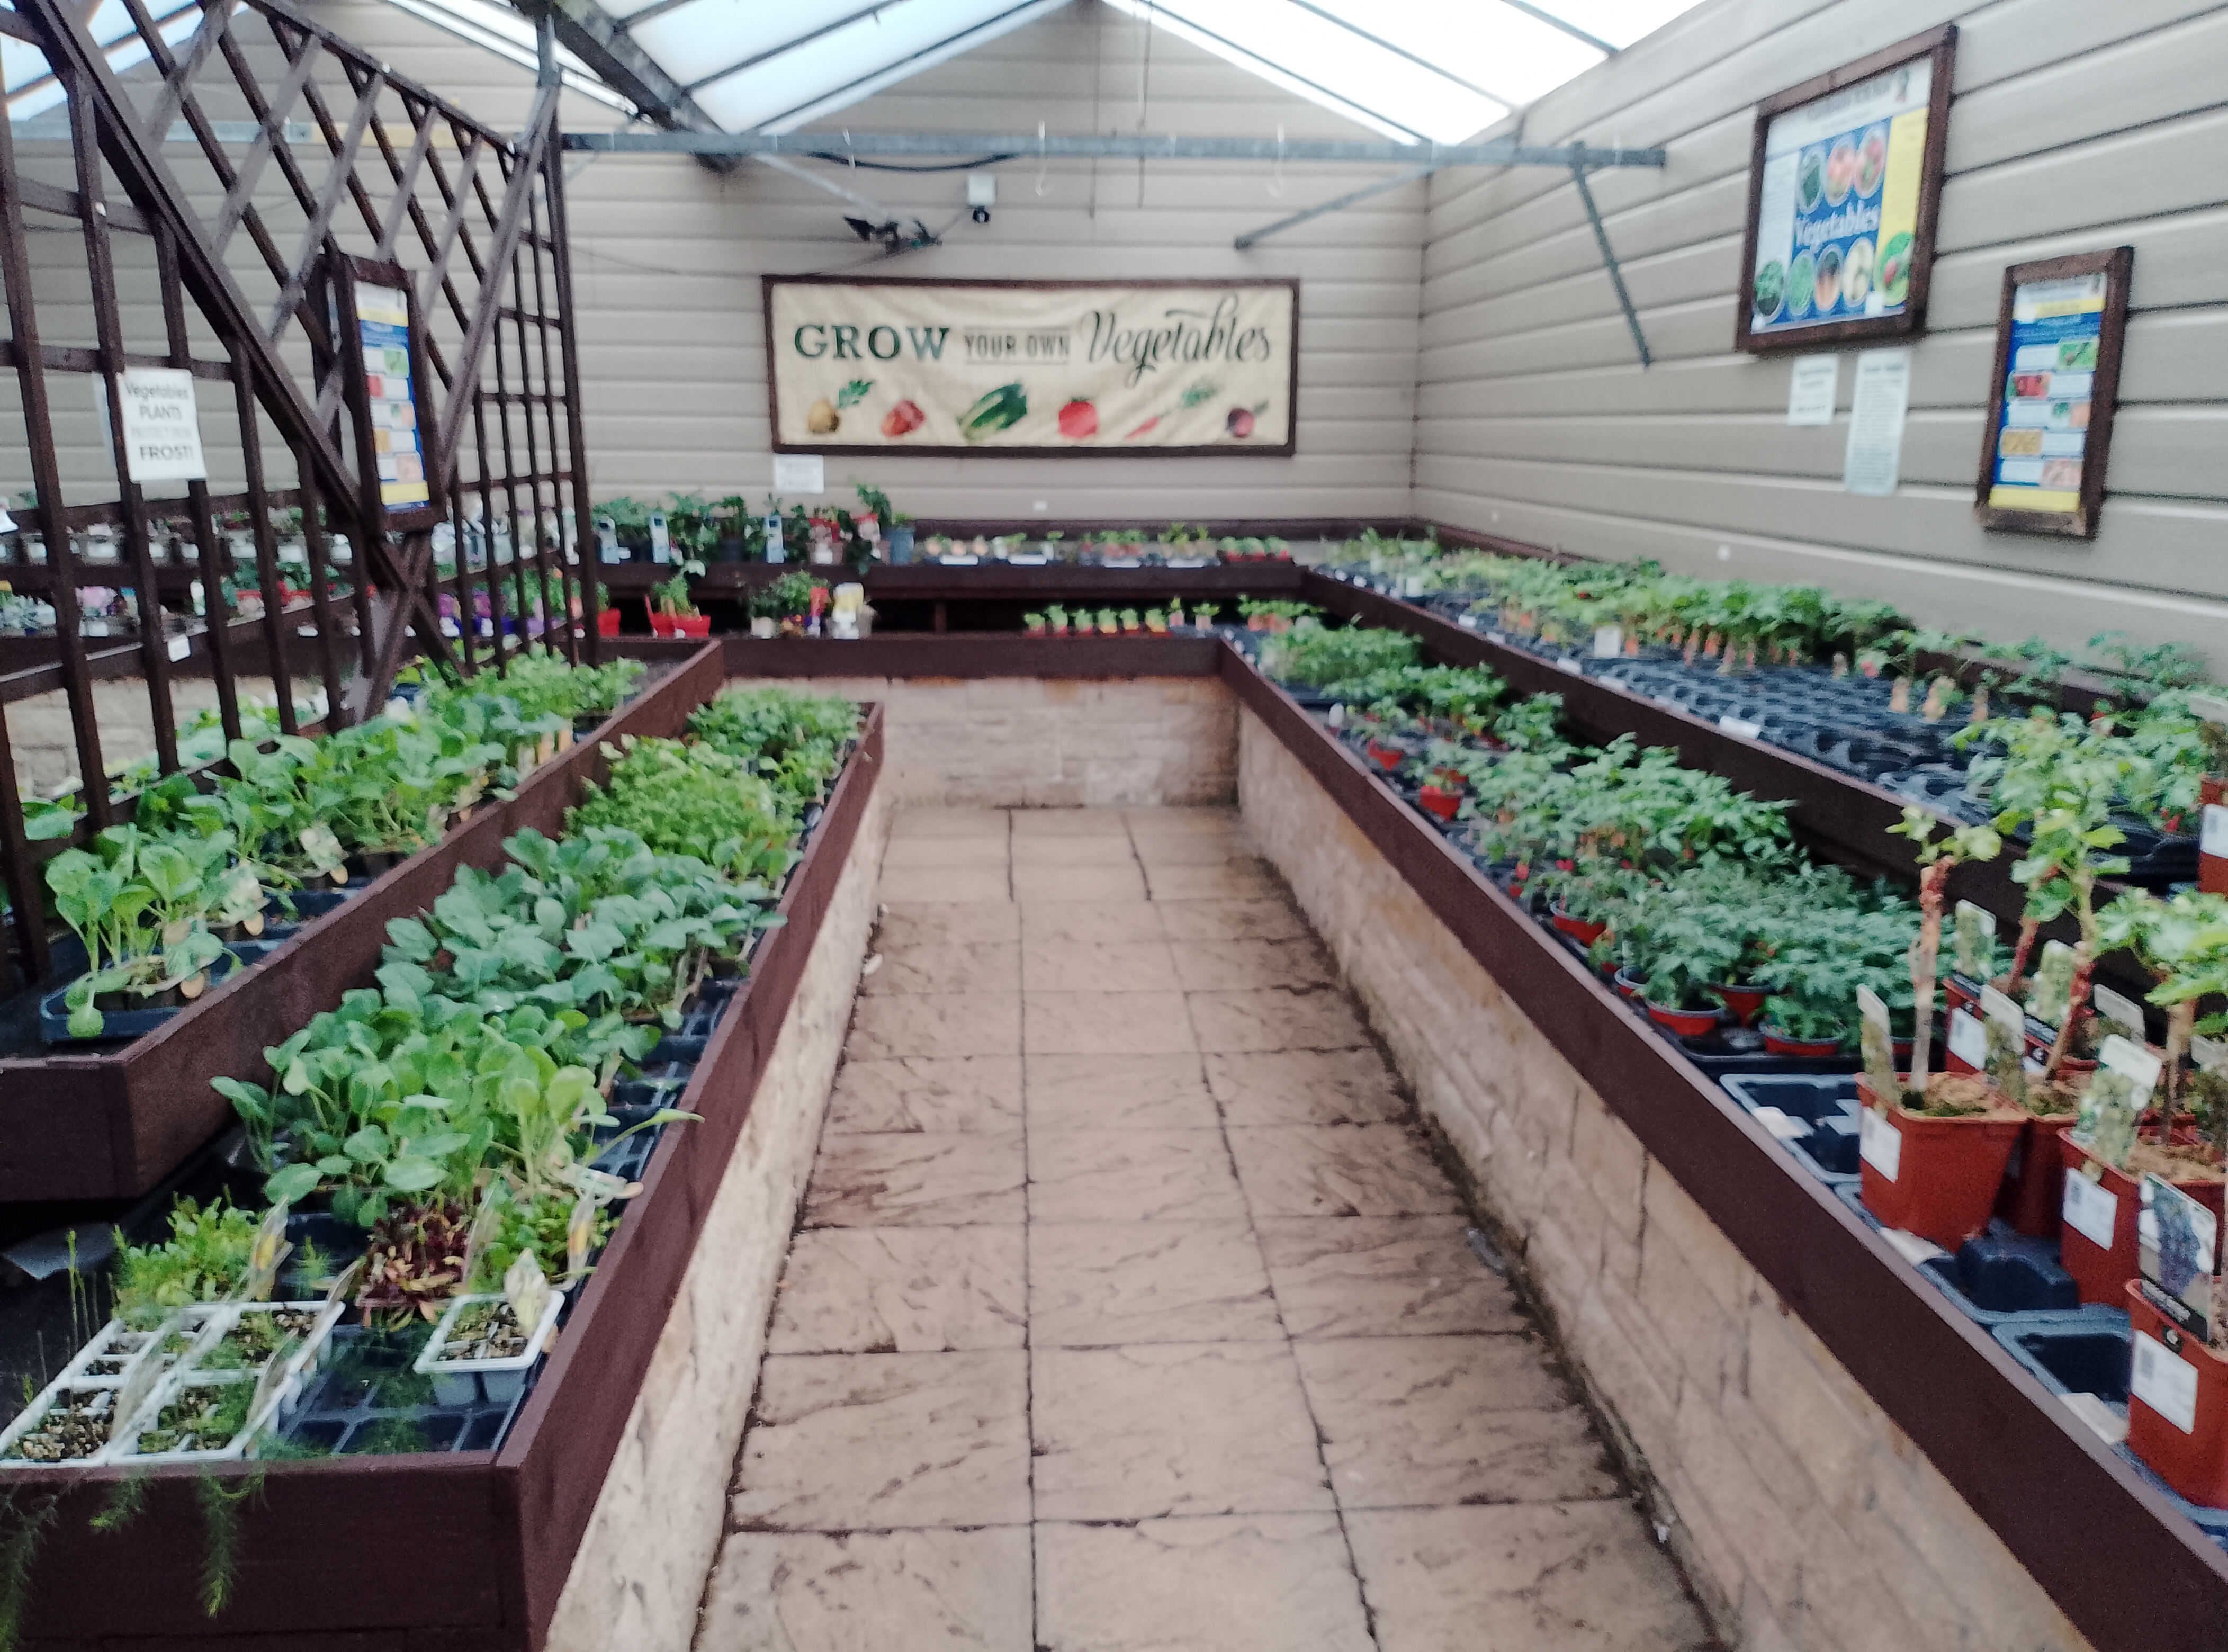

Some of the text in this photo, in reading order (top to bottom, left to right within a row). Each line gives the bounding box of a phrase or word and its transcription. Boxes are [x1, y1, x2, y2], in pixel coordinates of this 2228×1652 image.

[794, 292, 1270, 388] GROW YOUR OWN Vegetables
